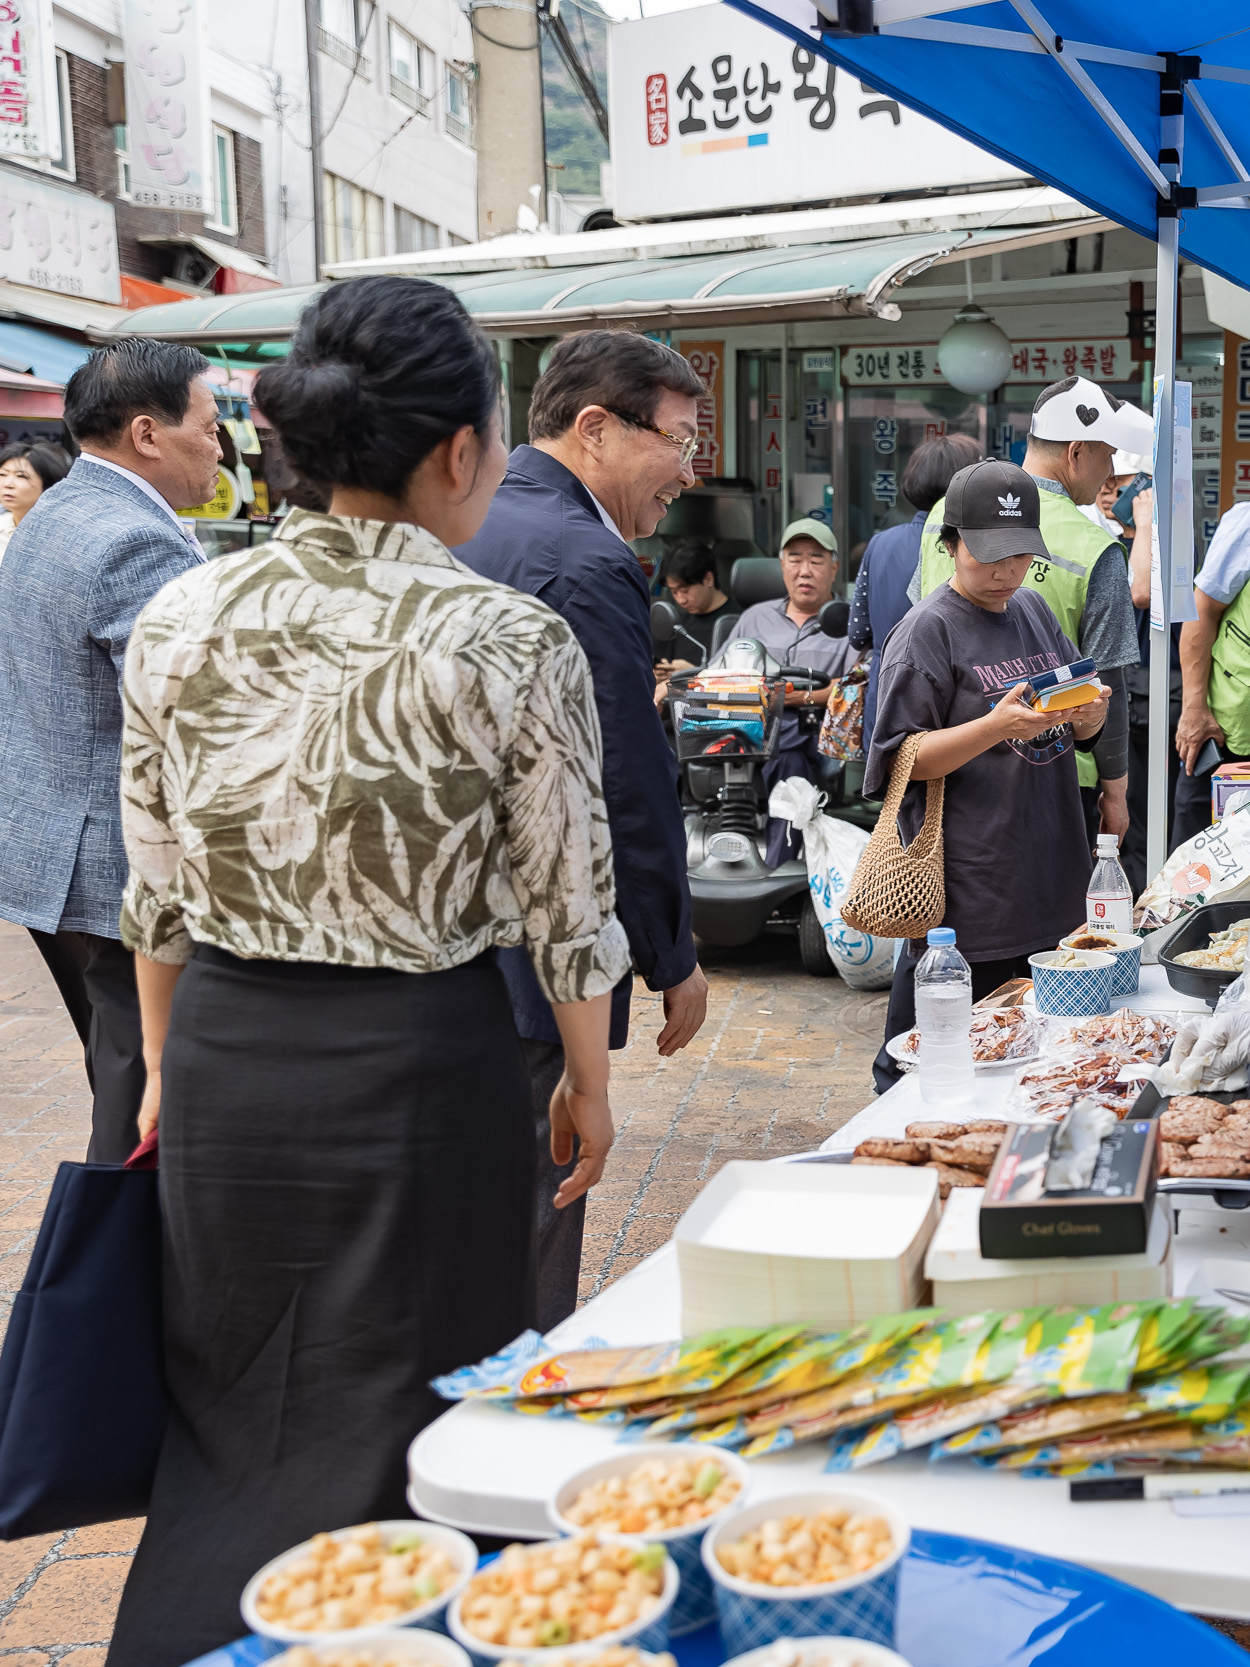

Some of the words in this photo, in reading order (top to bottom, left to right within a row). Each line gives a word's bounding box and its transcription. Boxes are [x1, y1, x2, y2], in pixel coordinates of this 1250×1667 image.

[676, 54, 781, 135] 소문난
[648, 76, 668, 144] 名家
[854, 352, 891, 379] 30년
[895, 350, 927, 379] 전통
[998, 509, 1022, 517] adidas
[1021, 1221, 1055, 1237] Chef
[1056, 1220, 1101, 1236] Gloves
